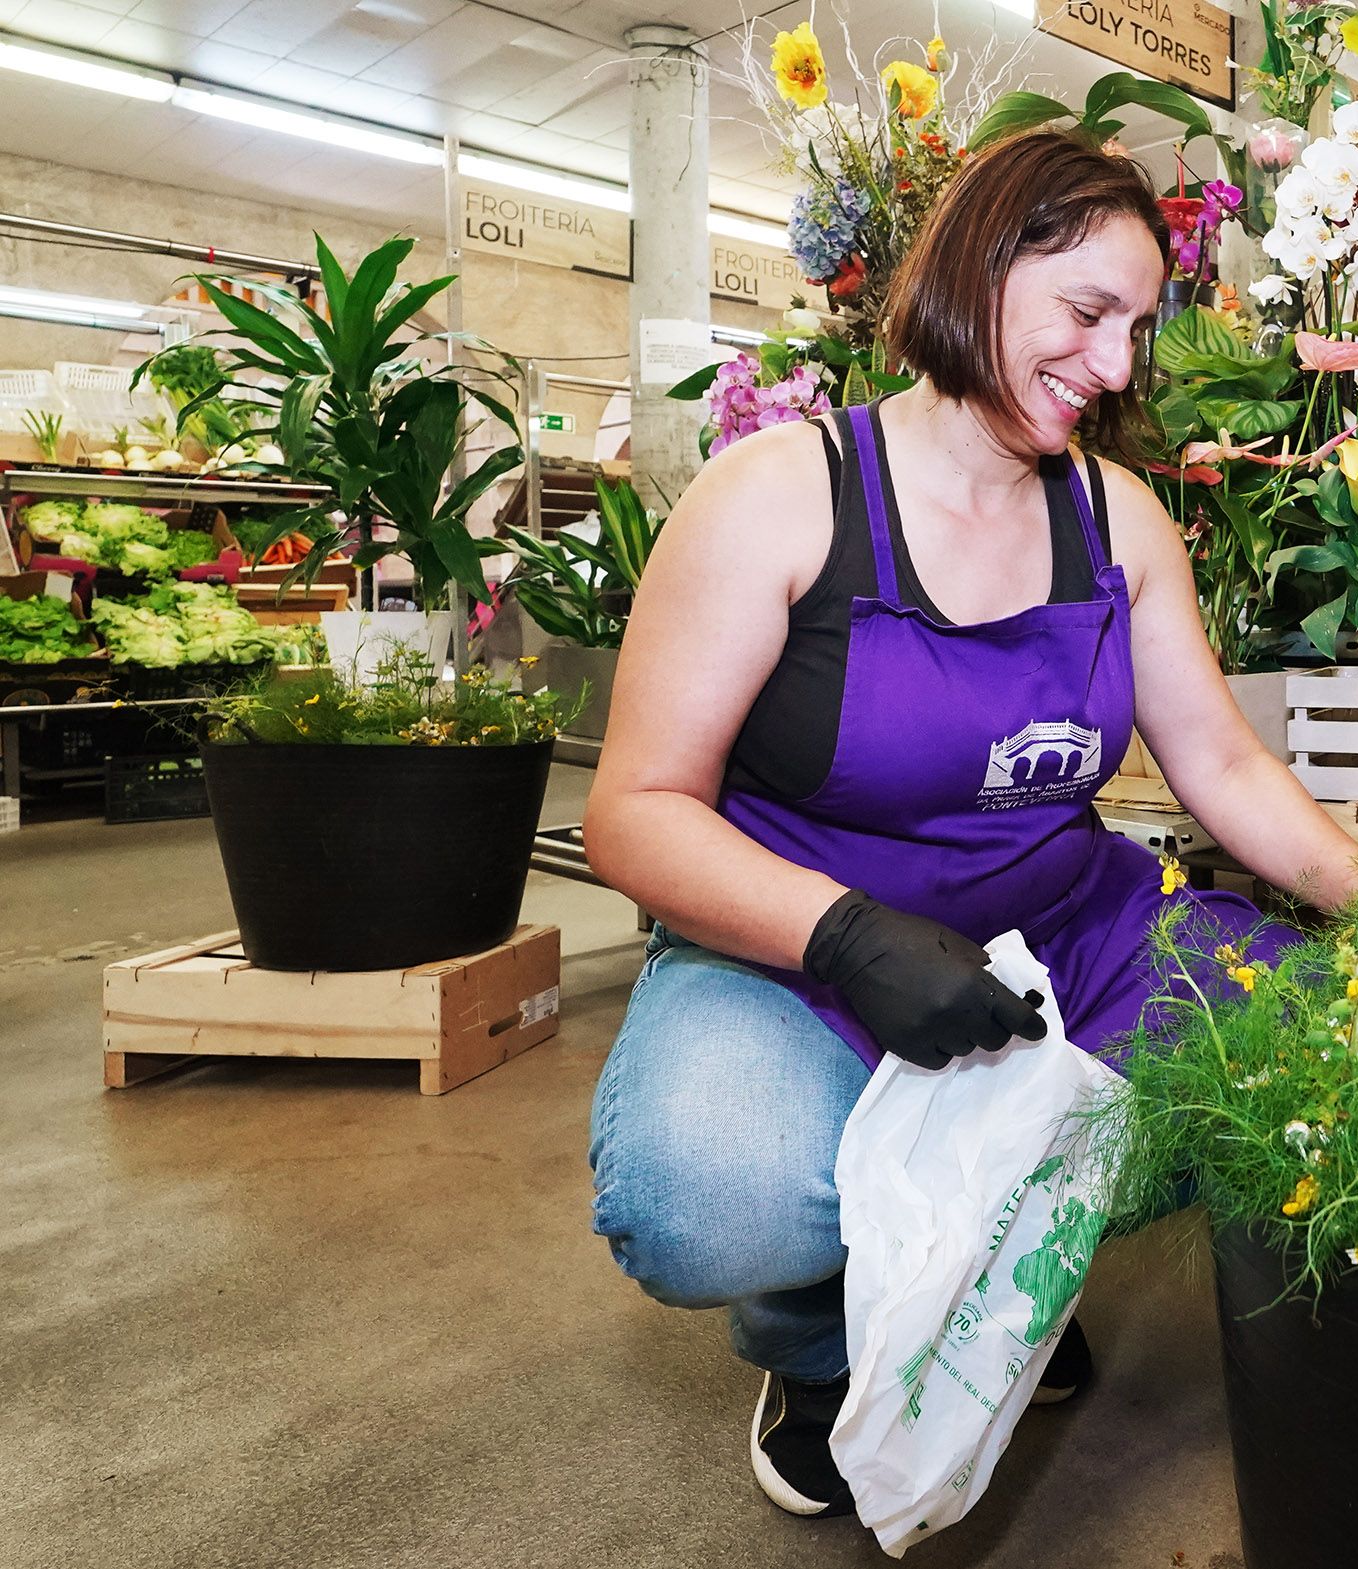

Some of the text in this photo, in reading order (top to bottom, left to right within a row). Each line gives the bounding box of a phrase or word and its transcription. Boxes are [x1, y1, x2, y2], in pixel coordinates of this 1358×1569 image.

[1068, 0, 1212, 77] LOLY TORRES
[1193, 12, 1231, 36] MERCADO
[466, 191, 596, 238] FROITERÍA
[466, 217, 524, 248] LOLI
[714, 270, 758, 295] LOLI
[948, 1366, 963, 1384] DEL
[963, 1379, 983, 1400] REAL
